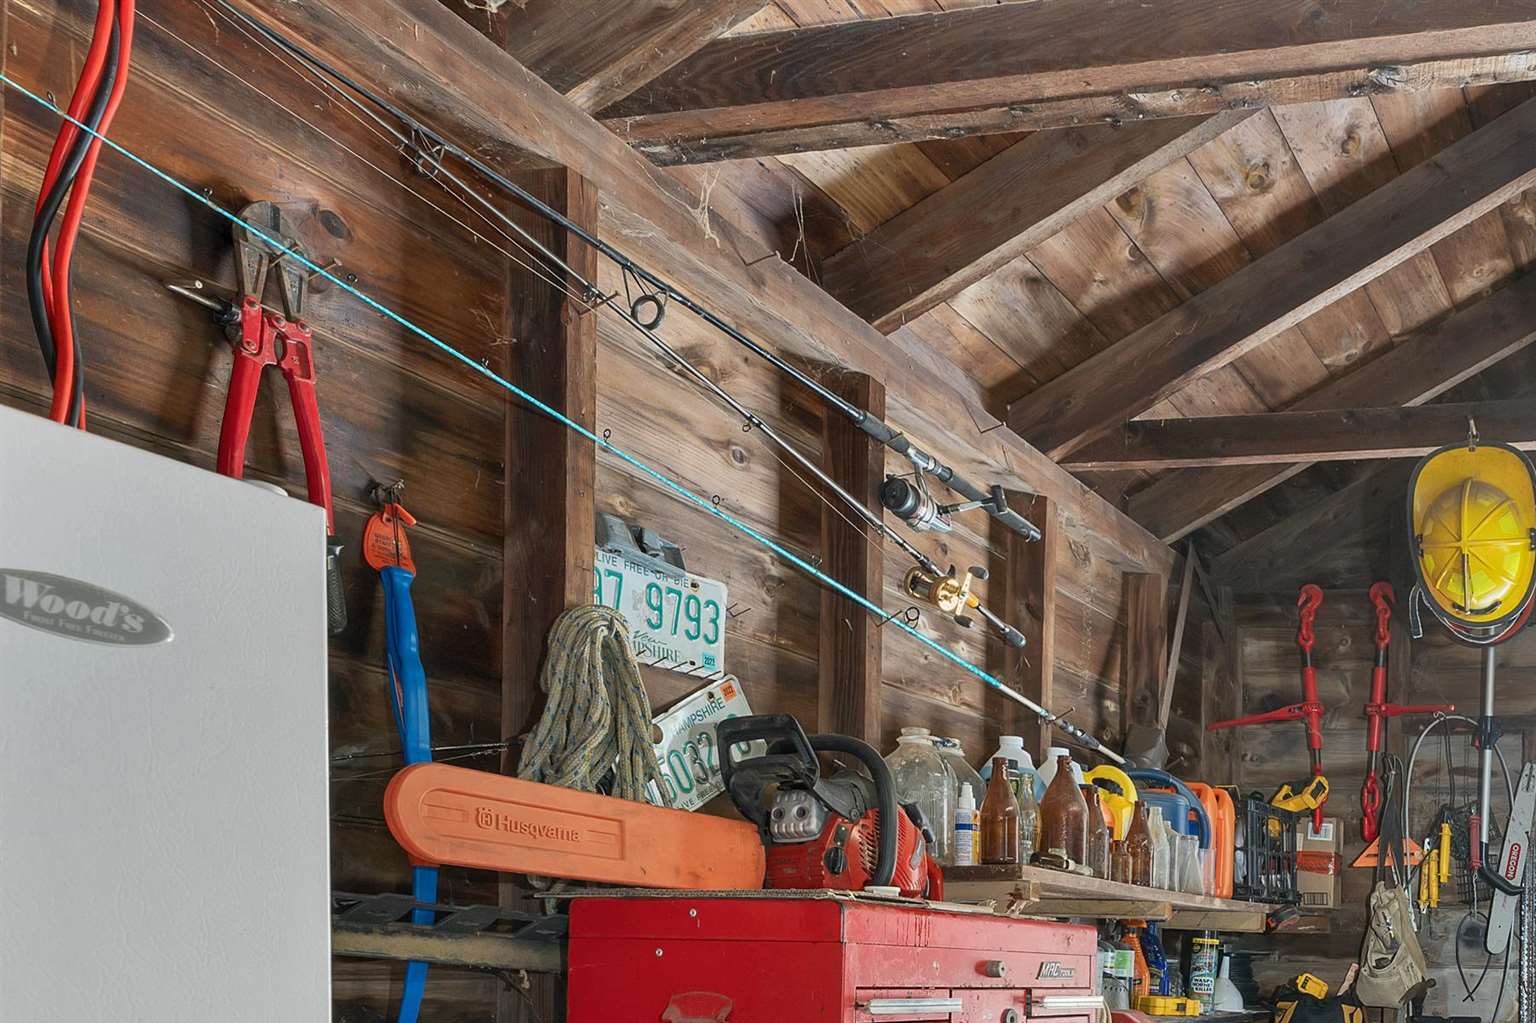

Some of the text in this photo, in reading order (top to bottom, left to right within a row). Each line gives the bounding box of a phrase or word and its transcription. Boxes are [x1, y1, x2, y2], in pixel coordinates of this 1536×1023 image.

[596, 552, 618, 567] LIVE
[624, 560, 650, 577] FREE
[2, 574, 145, 633] Wood's
[646, 582, 720, 645] 9793
[495, 813, 581, 844] Husqvarna
[1505, 844, 1520, 879] OREGON
